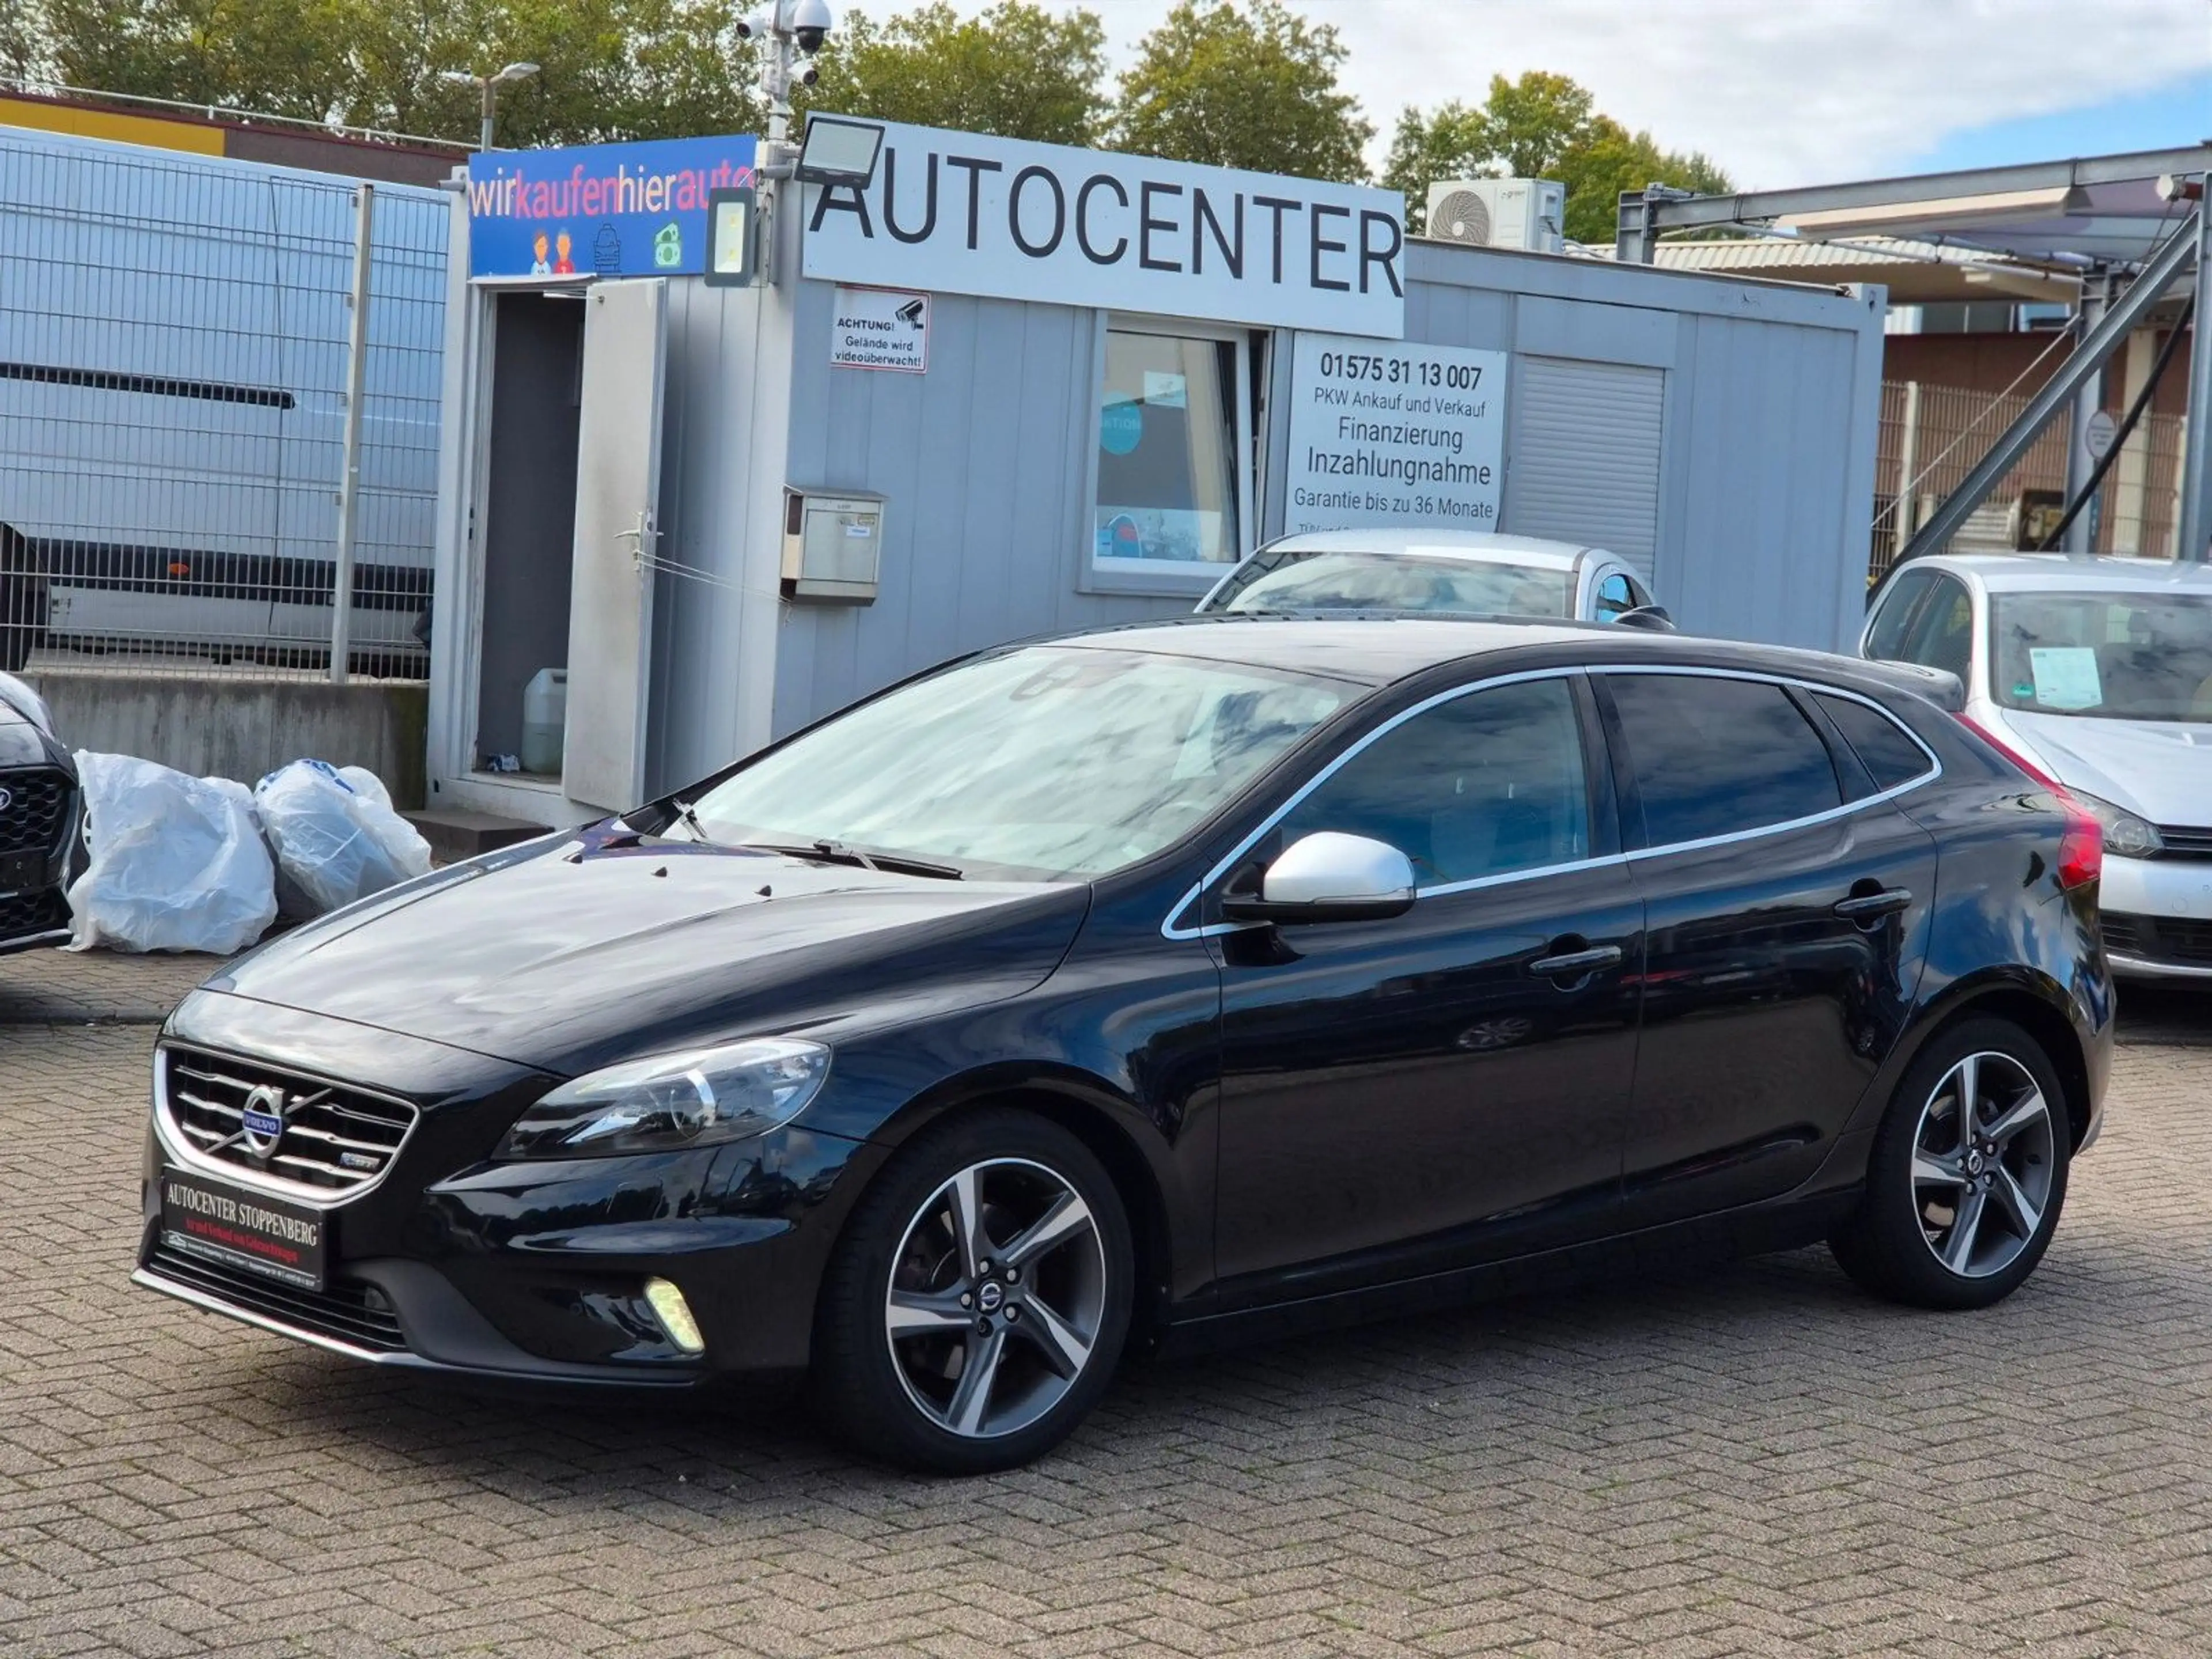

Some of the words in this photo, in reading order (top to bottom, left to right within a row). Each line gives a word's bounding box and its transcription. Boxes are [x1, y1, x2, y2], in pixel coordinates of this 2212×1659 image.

[809, 146, 1403, 297] AUTOCENTER
[837, 317, 894, 331] ACHTUNG!
[835, 351, 921, 367] videoüberwacht!
[846, 335, 888, 349] Gelände
[891, 339, 914, 351] wird
[1321, 353, 1383, 381] 01575
[1388, 359, 1410, 384] 31
[1419, 362, 1441, 386] 13
[1447, 365, 1482, 391] 007
[1315, 387, 1349, 405] PKW
[1353, 390, 1403, 410] Ankauf
[1406, 397, 1431, 413] und
[1435, 397, 1486, 418] Verkauf
[1339, 416, 1463, 454] Finanzierung
[1308, 446, 1491, 486] Inzahlungnahme
[1294, 487, 1361, 509] Garantie
[1366, 491, 1388, 512] bis
[1392, 497, 1410, 513] zu
[1415, 495, 1433, 514] 36
[1438, 497, 1493, 518] Monate
[167, 1183, 237, 1222] AUTOCENTER
[238, 1203, 317, 1247] STOPPENBERG
